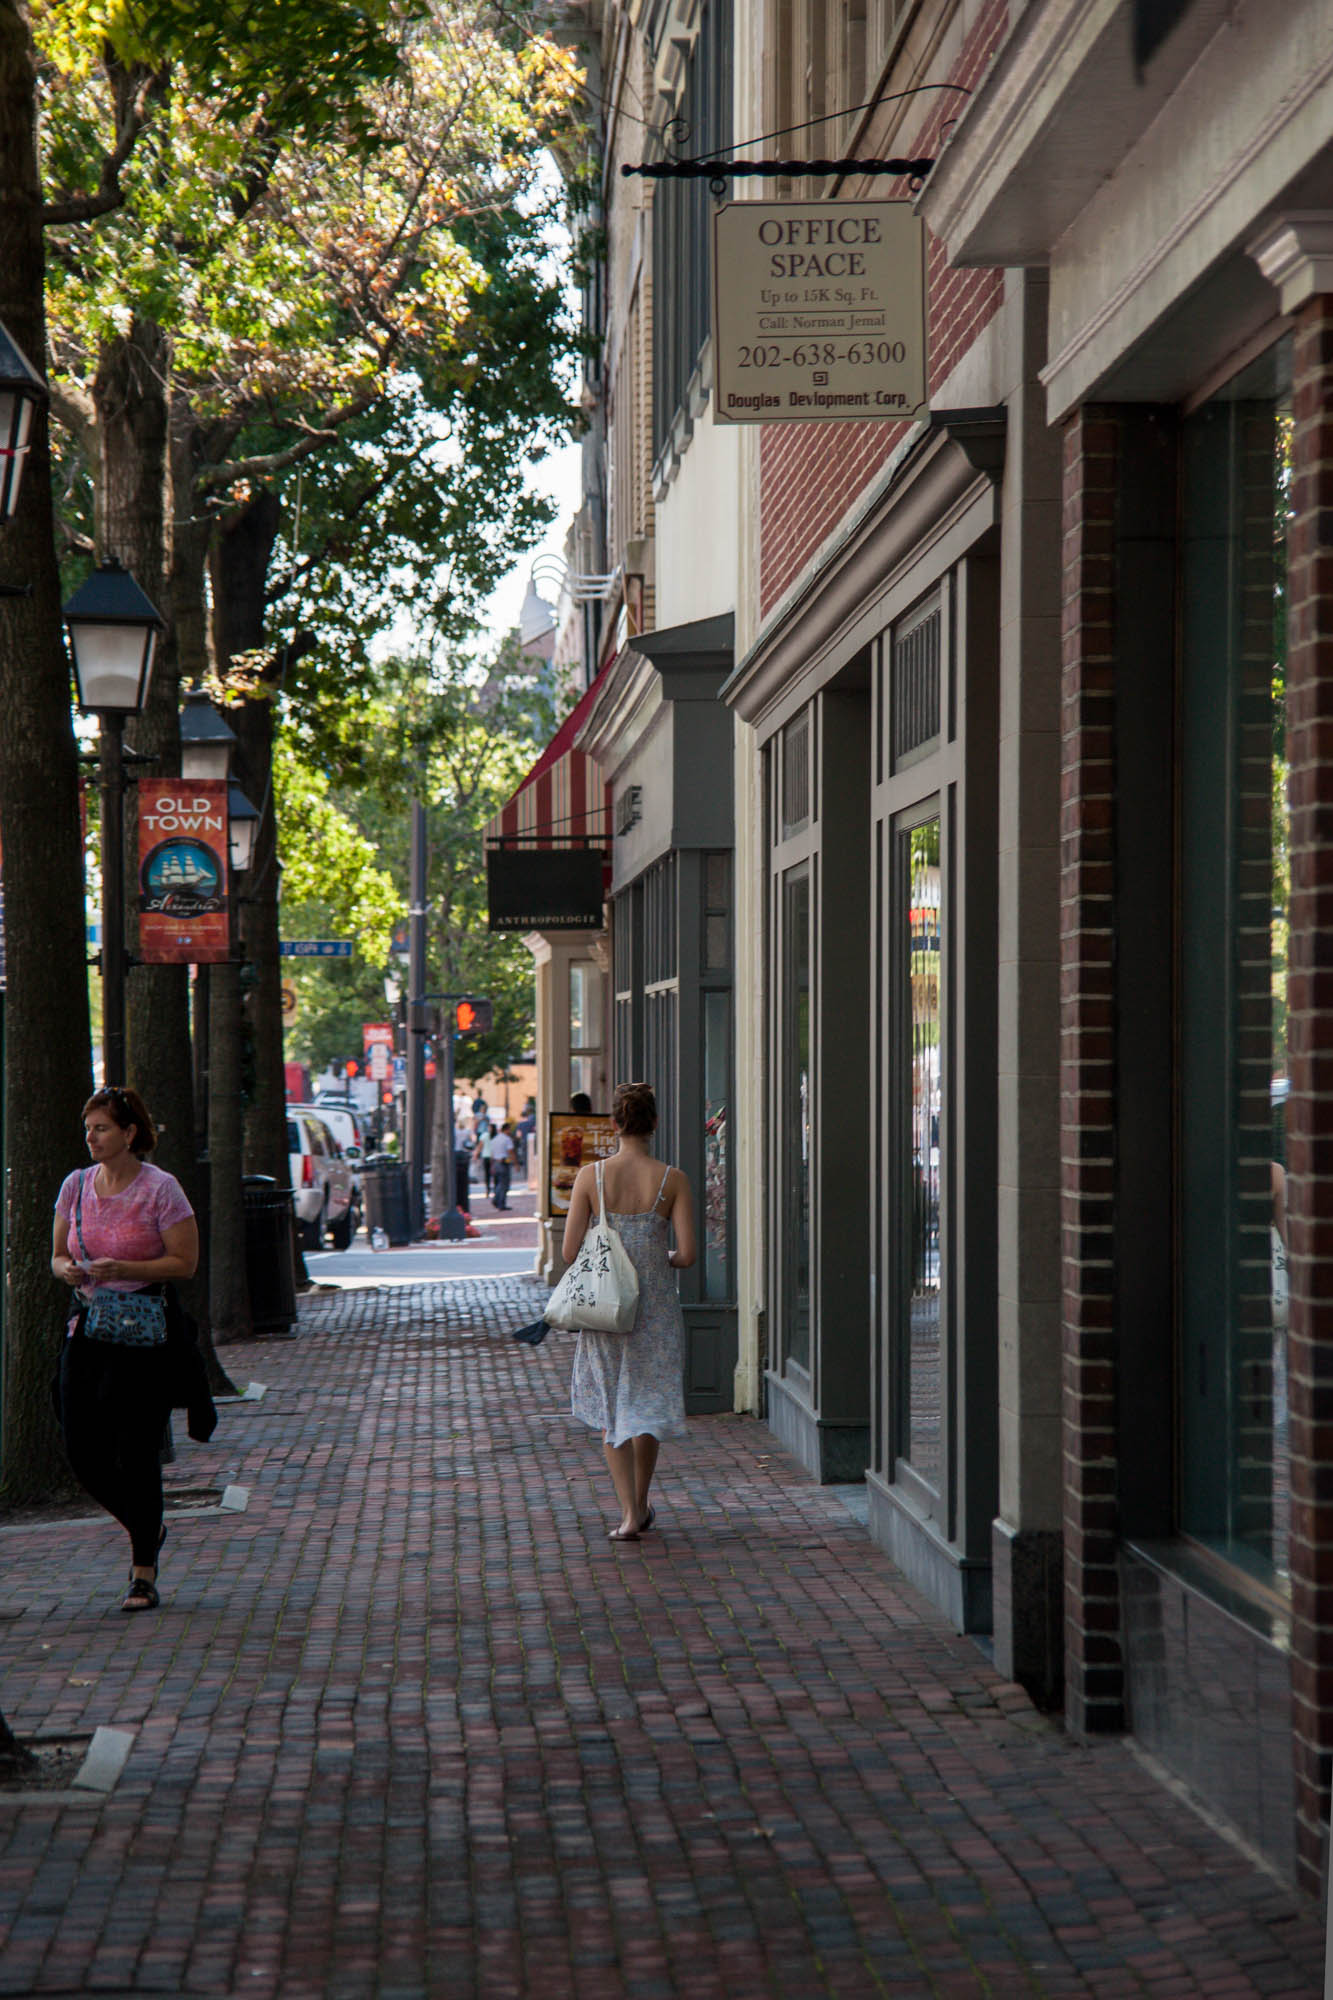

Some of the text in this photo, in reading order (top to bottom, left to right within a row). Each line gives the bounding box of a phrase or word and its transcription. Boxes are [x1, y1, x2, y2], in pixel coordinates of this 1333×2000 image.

[758, 218, 882, 246] OFFICE
[770, 253, 866, 278] SPACE
[761, 288, 878, 306] Up to 15K Sq. Ft.
[759, 314, 885, 330] Call: Norman Jemal
[737, 341, 906, 368] 202-638-6300
[727, 390, 910, 411] Douglas Devlopment Corp.
[155, 797, 211, 813] OLD
[143, 816, 223, 831] TOWN
